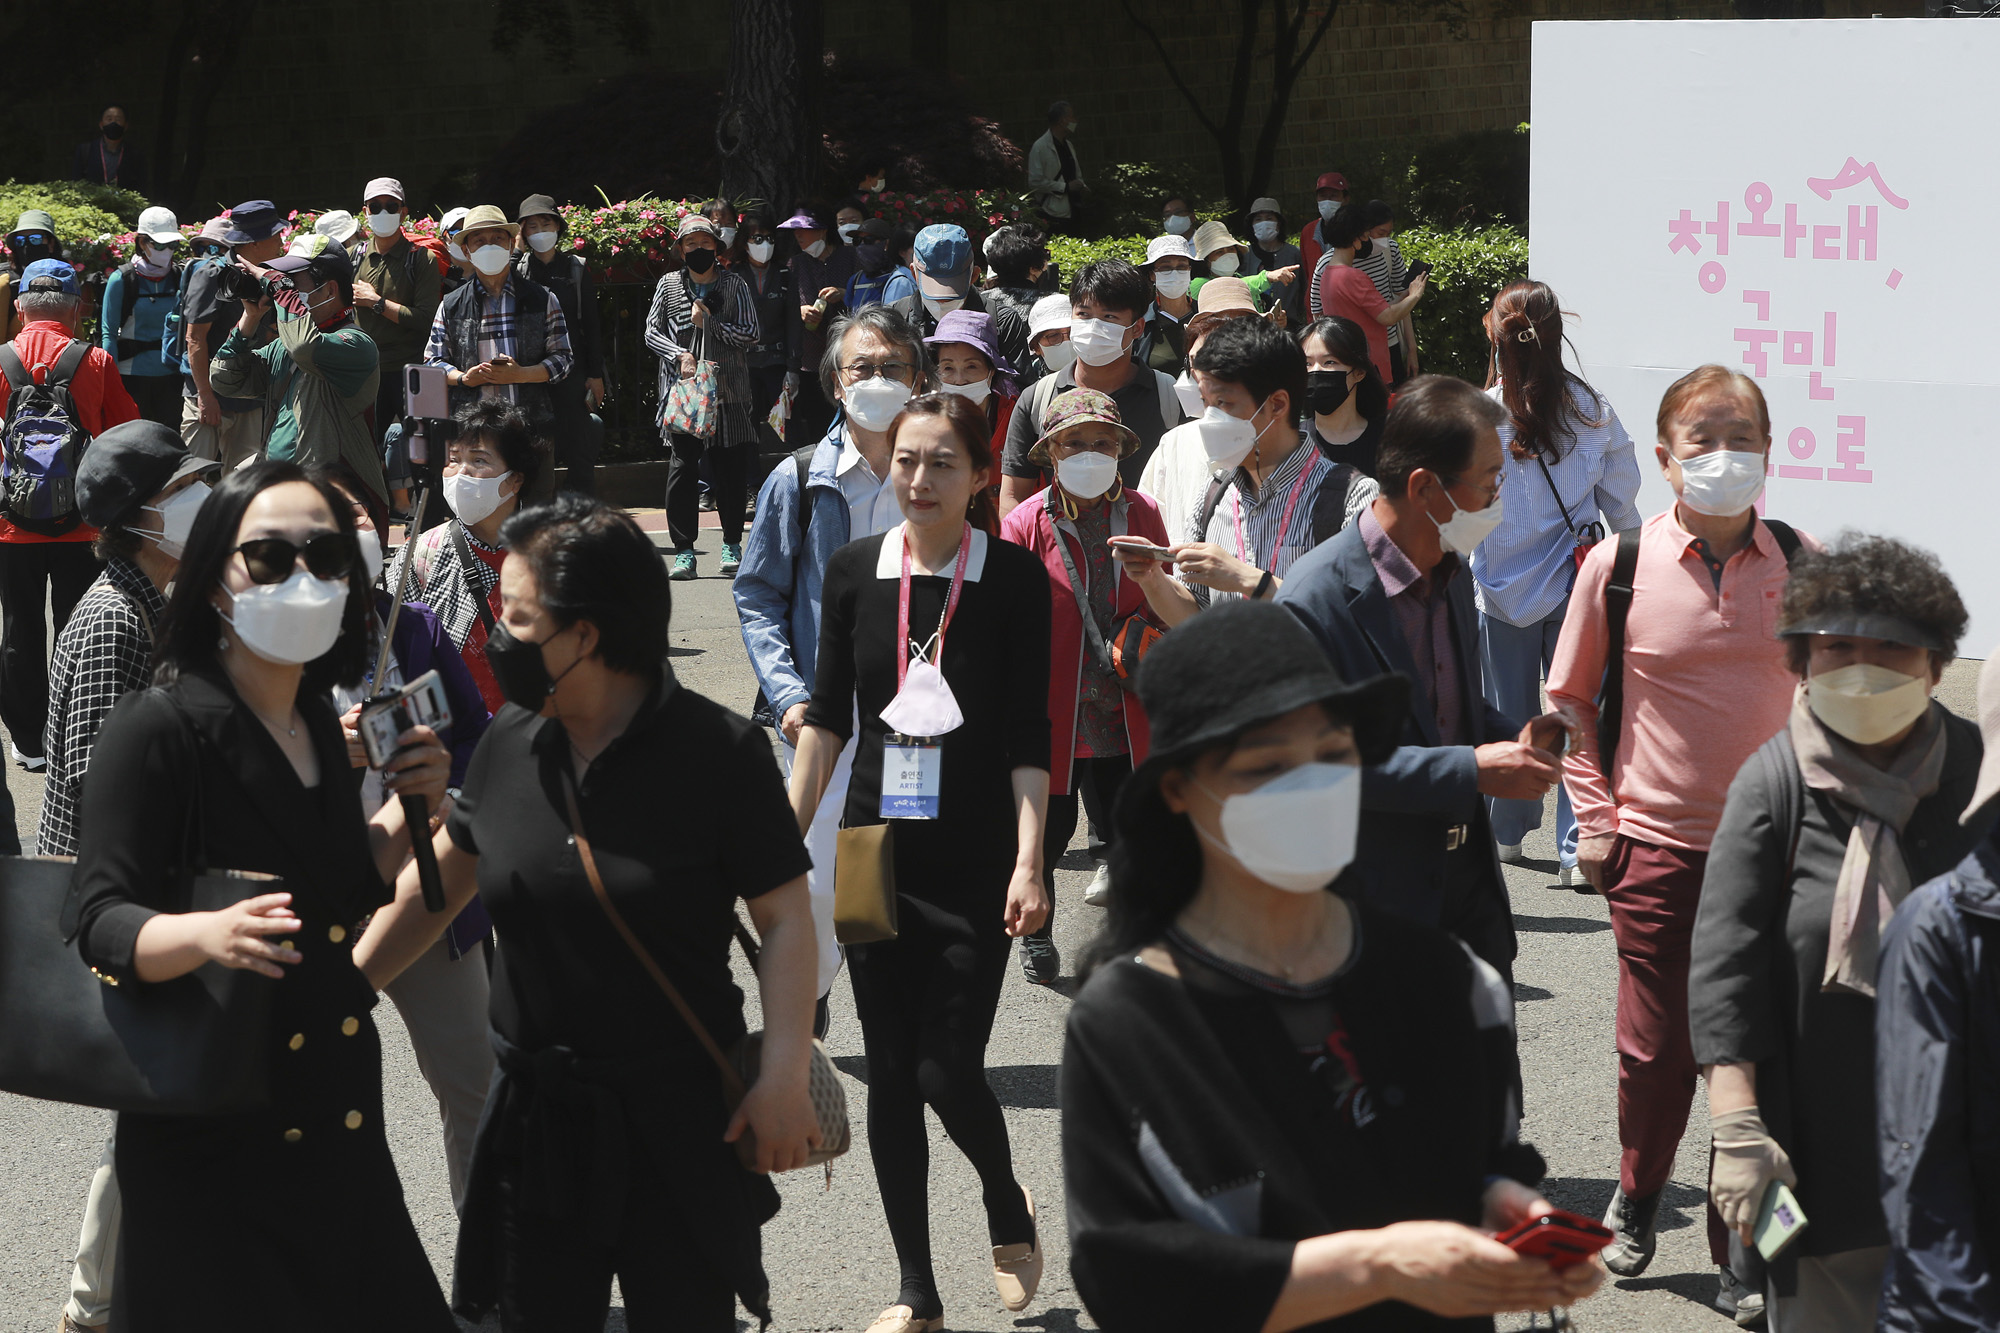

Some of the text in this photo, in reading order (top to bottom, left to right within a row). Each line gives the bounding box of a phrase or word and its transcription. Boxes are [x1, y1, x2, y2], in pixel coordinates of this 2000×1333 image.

[1734, 290, 1837, 401] 국민
[1754, 415, 1873, 517] 으로
[899, 782, 924, 790] ARTIST
[900, 771, 924, 780] 출연진
